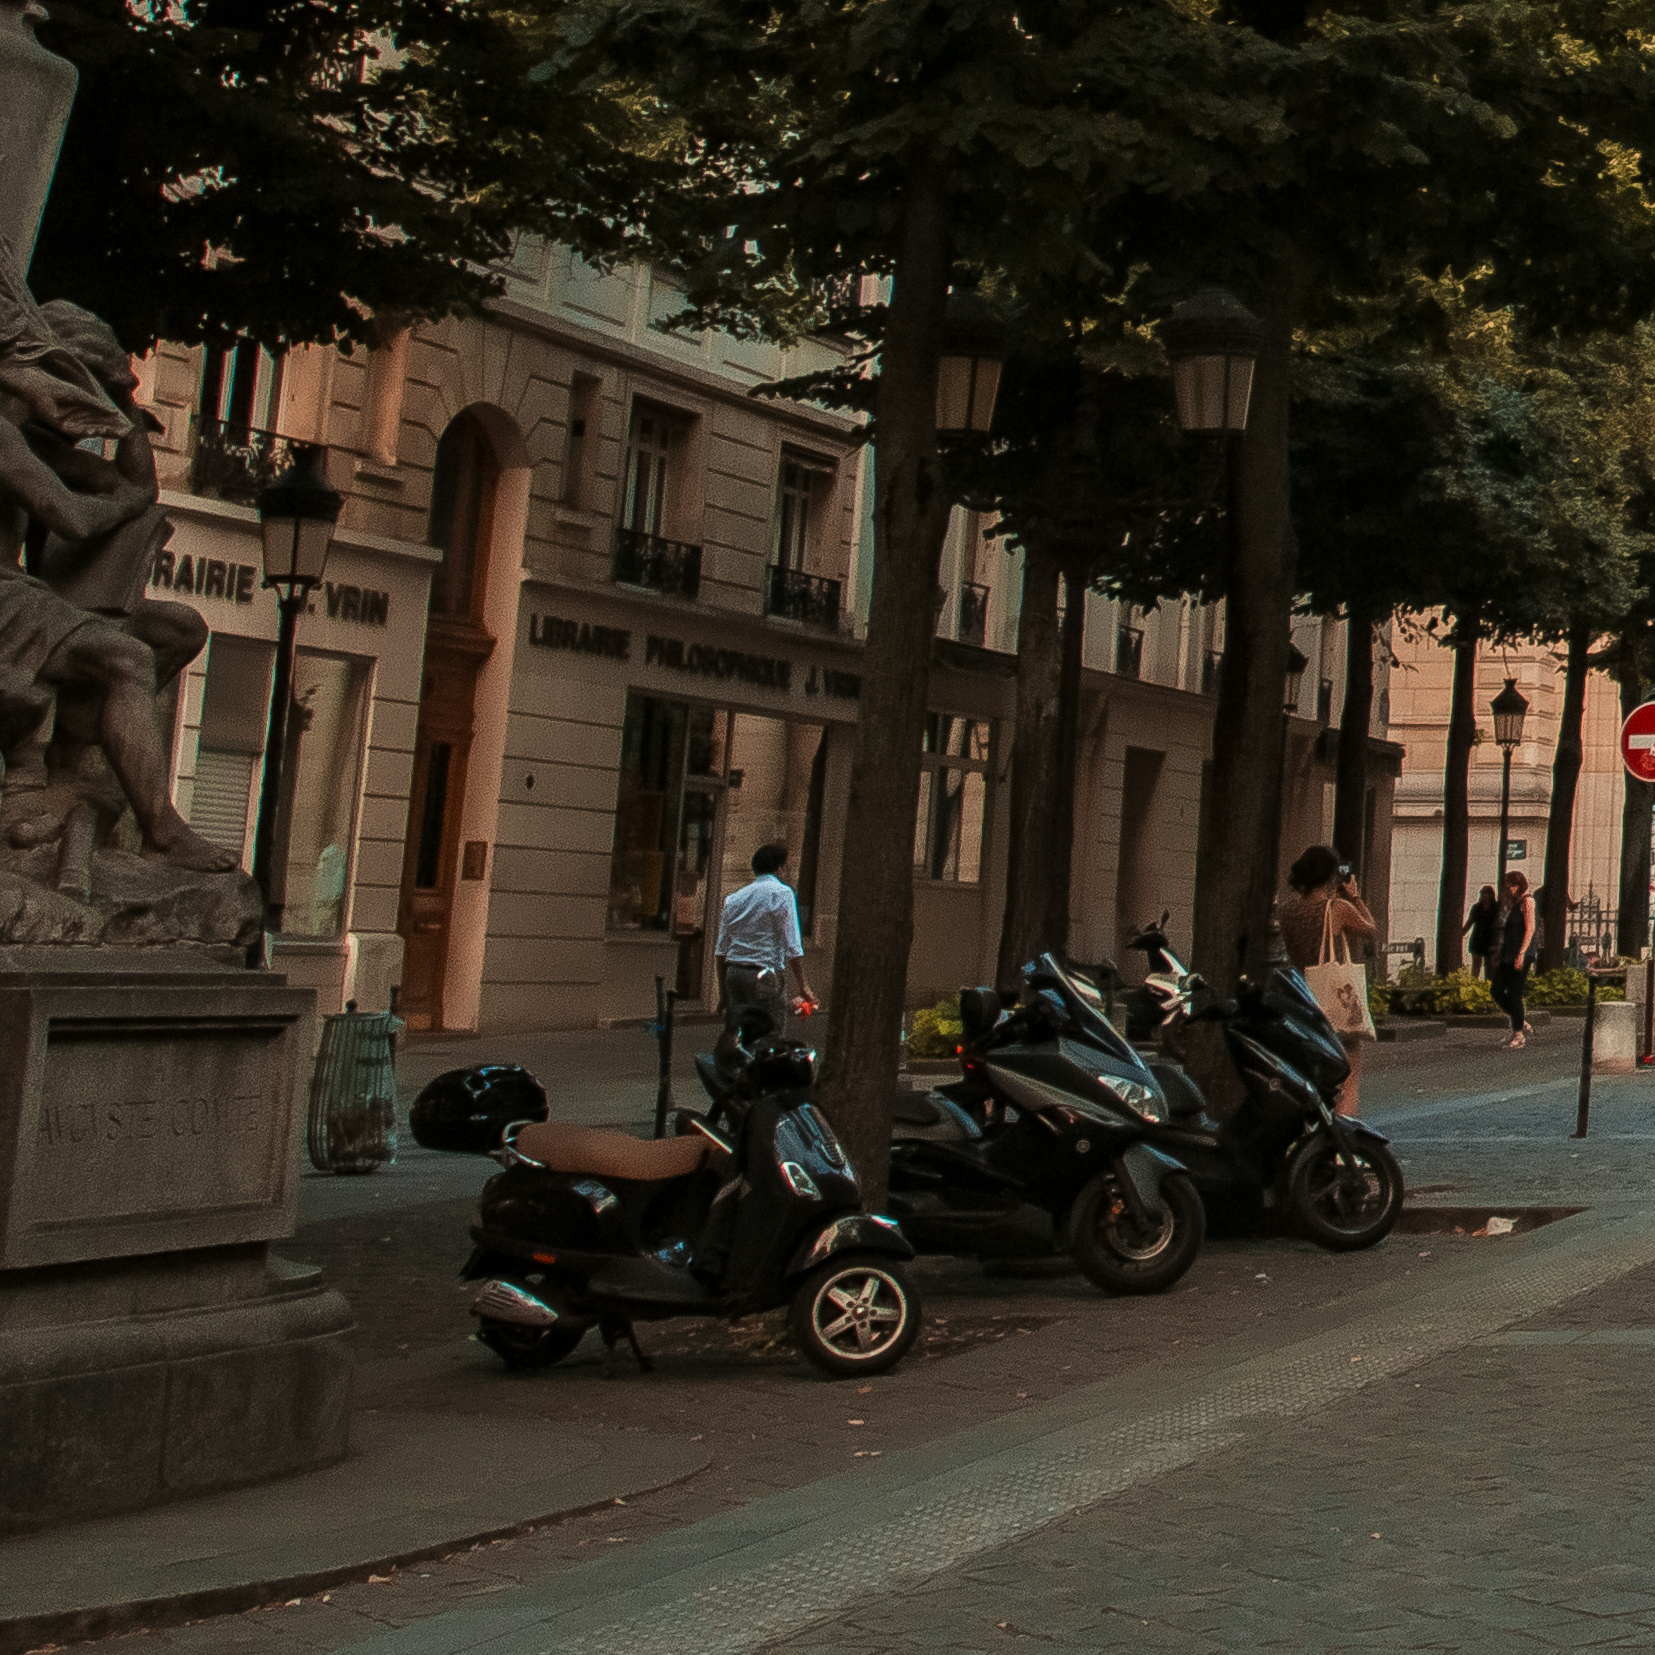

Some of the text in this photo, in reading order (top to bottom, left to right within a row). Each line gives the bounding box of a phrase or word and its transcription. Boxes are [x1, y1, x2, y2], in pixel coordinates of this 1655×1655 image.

[152, 549, 256, 604] RAIRIE
[326, 581, 390, 625] VRIN
[528, 612, 634, 661] LIBRAIRIE
[645, 633, 793, 690] PHILOSOPHIQUE
